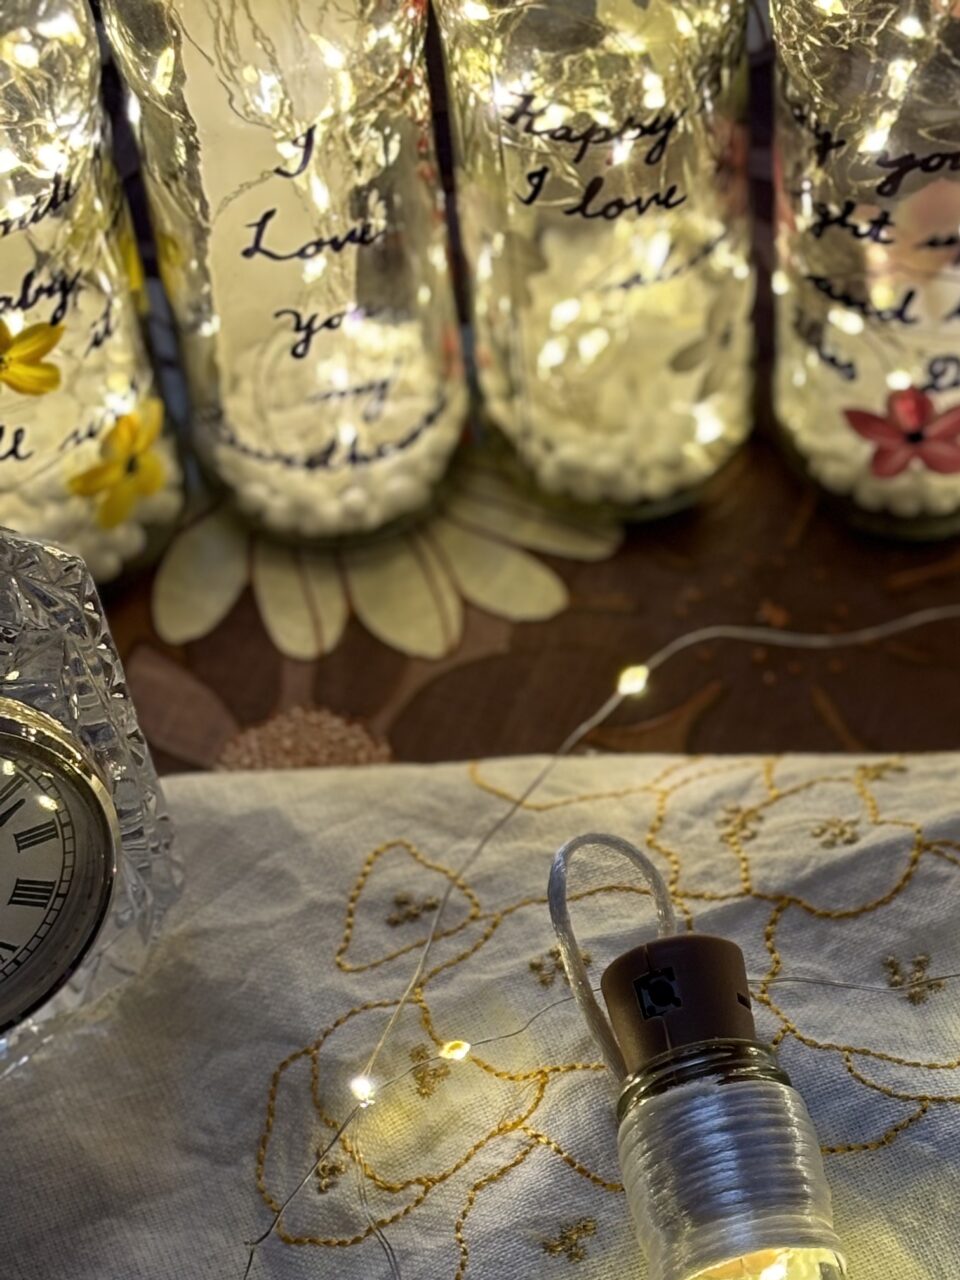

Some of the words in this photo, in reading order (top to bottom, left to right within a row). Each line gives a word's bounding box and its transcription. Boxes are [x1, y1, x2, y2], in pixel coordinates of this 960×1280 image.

[501, 90, 688, 165] Happy
[515, 165, 549, 205] I
[563, 176, 687, 220] love
[241, 208, 386, 261] Love
[273, 308, 352, 360] yo
